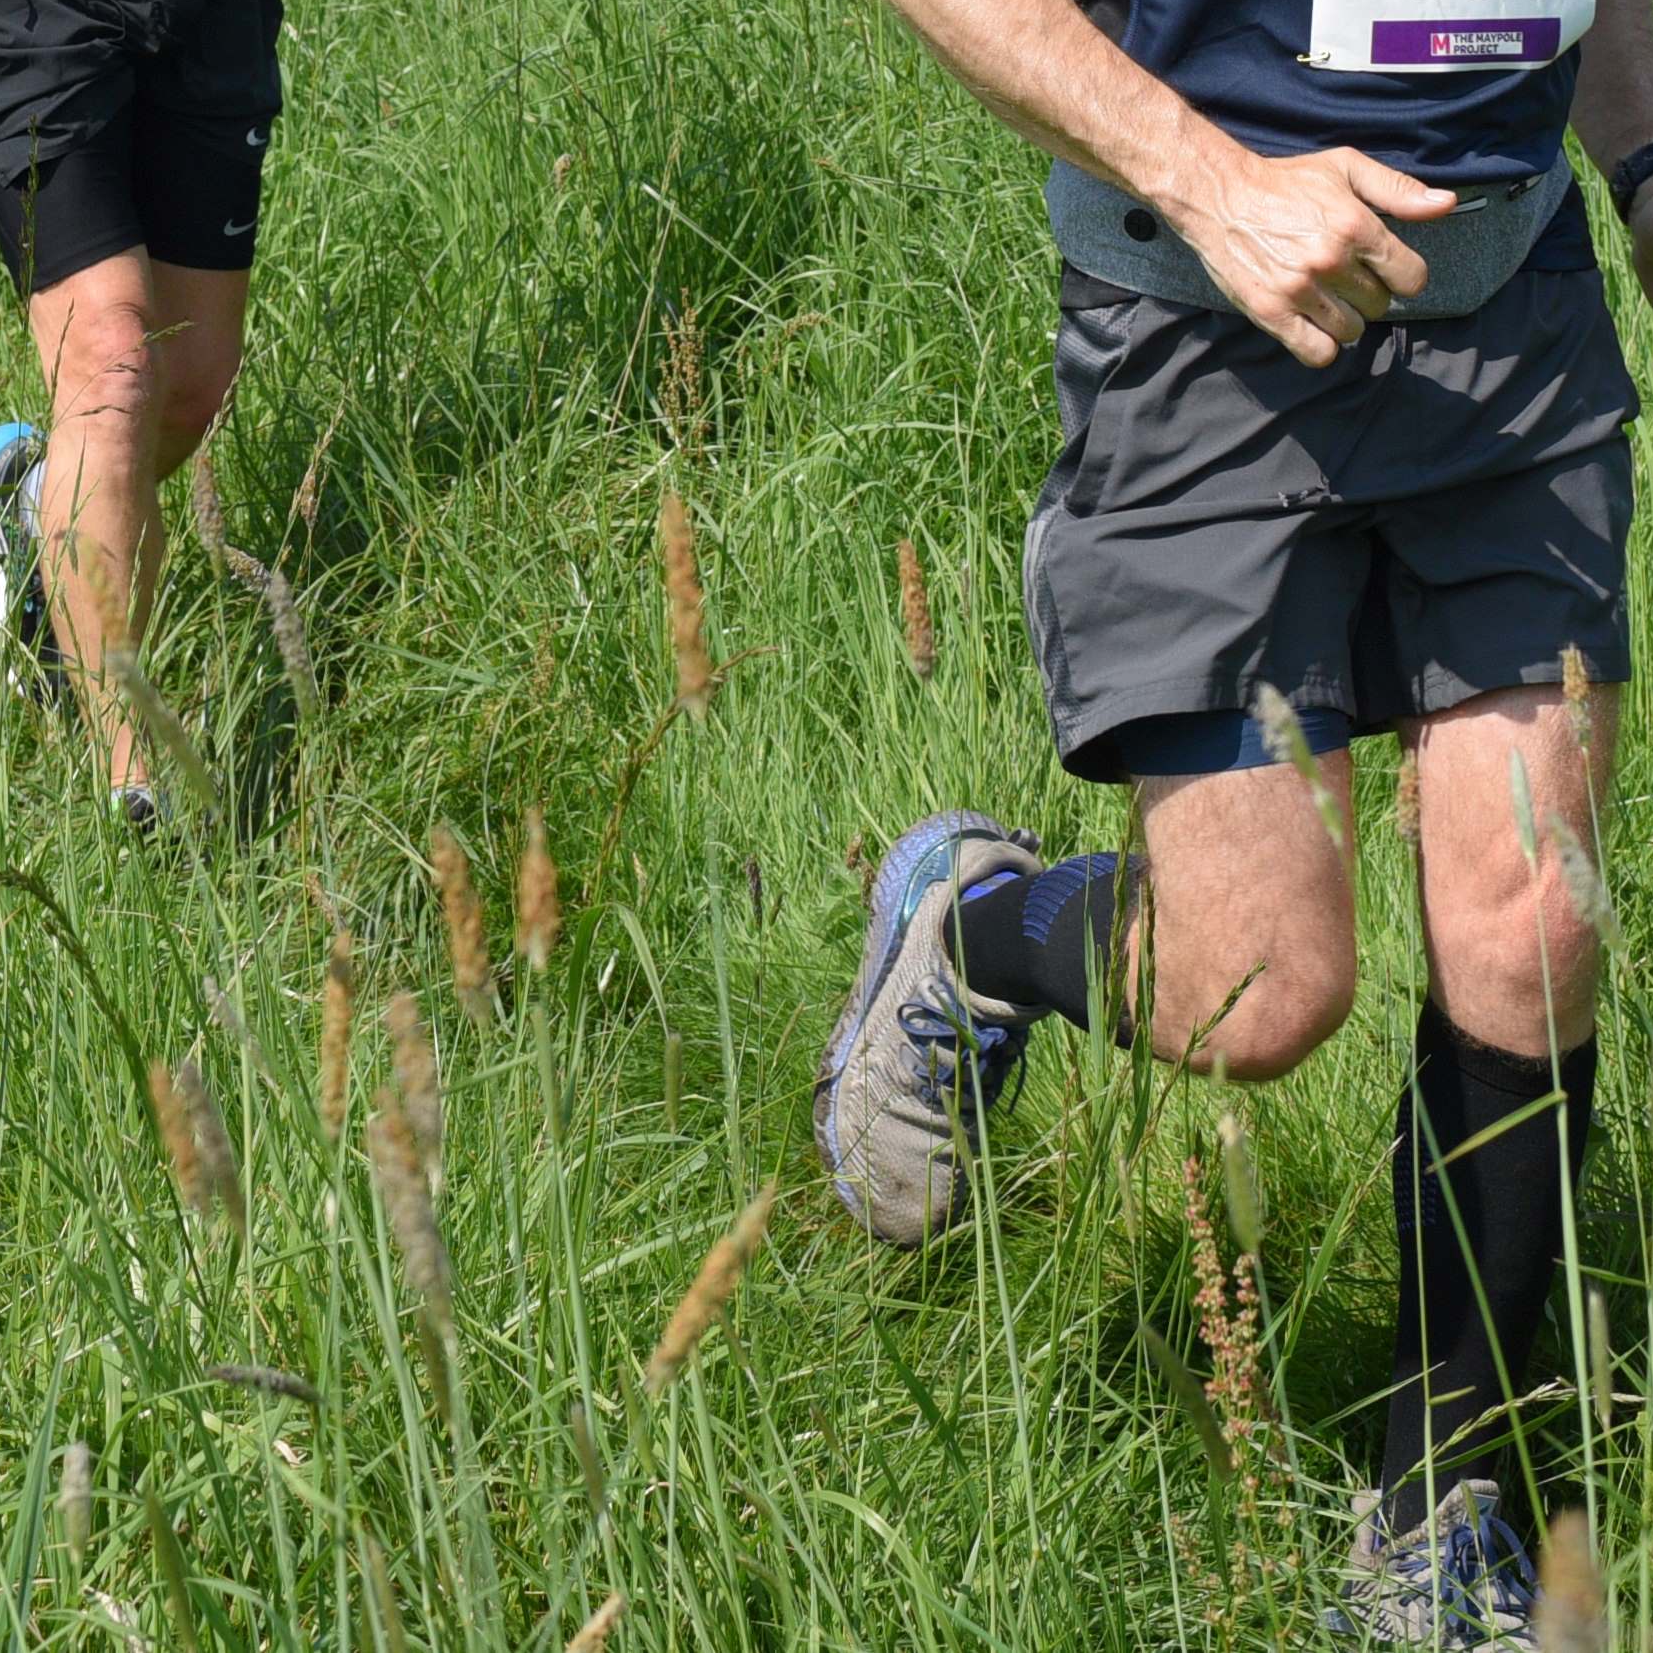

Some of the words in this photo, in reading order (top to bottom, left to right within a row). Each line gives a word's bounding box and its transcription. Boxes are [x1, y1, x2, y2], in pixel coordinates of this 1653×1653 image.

[1453, 33, 1475, 44] THE
[1476, 33, 1523, 43] MAYPOLE
[1453, 44, 1499, 54] PROJECT
